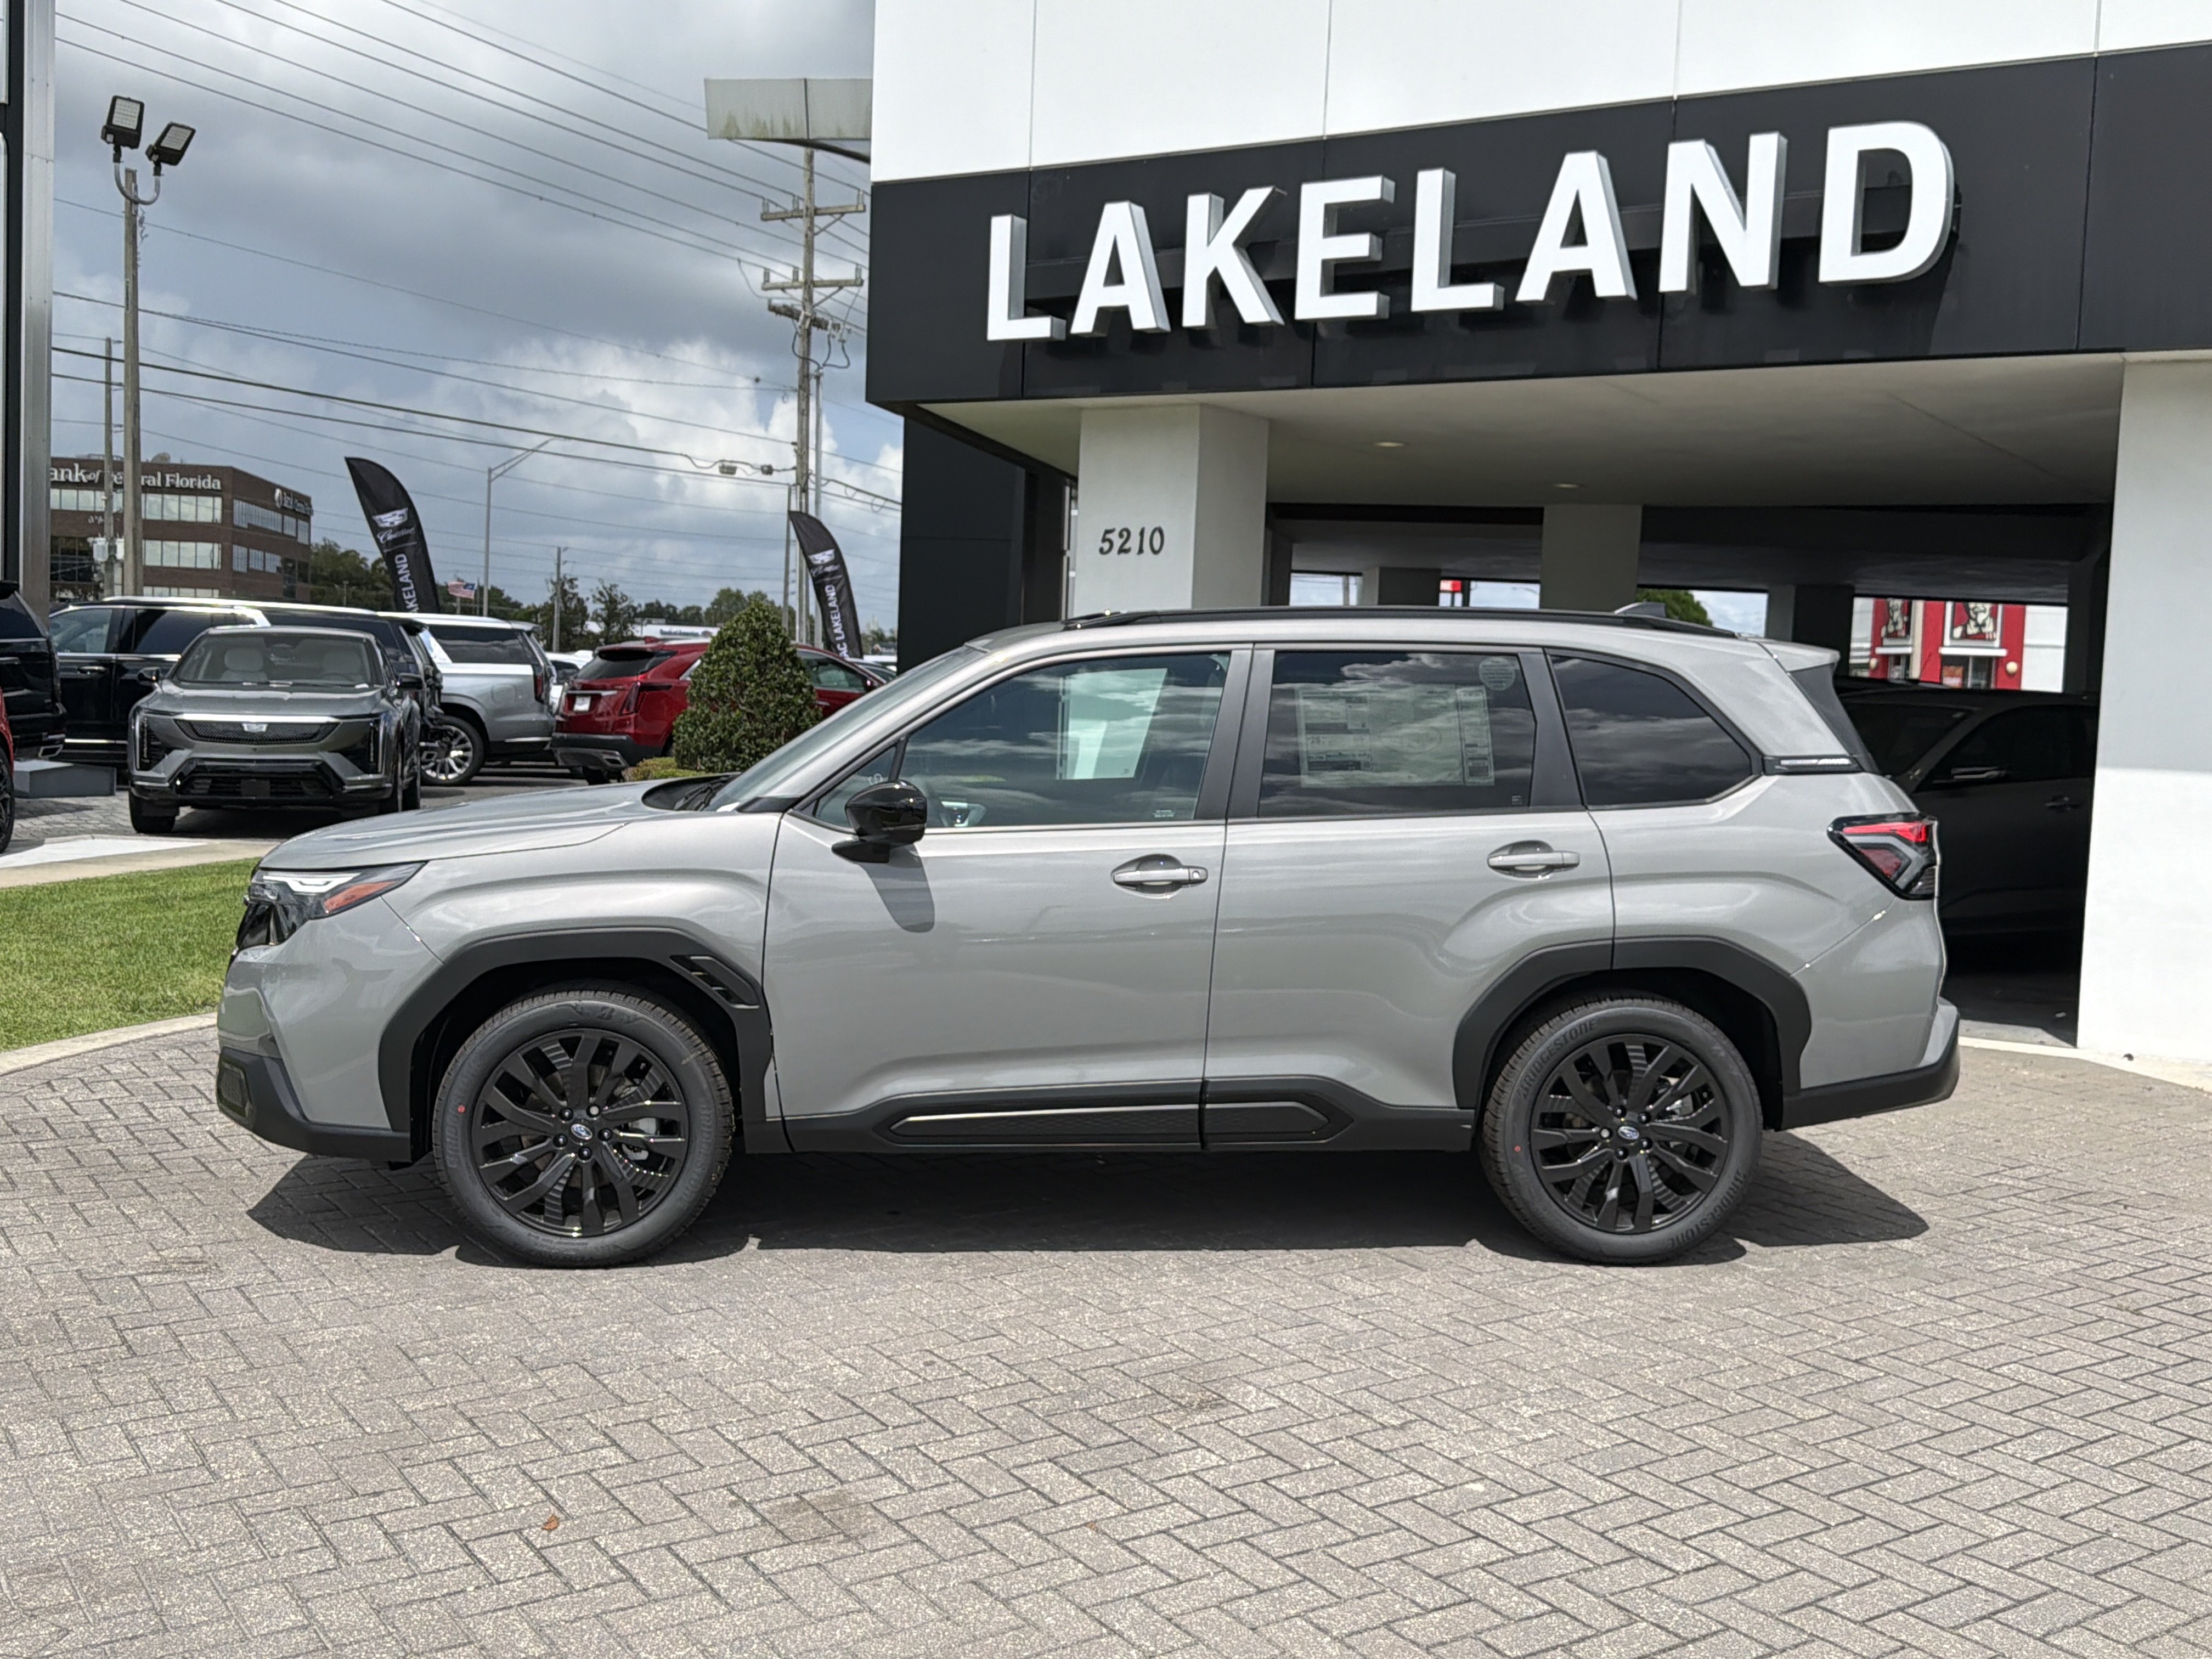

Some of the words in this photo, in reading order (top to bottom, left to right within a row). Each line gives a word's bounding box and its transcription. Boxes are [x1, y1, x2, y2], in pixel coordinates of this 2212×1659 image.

[988, 120, 1955, 341] LAKELAND
[50, 463, 87, 482] ank
[86, 470, 102, 483] of
[165, 473, 222, 489] Florida
[1099, 526, 1164, 555] 5210
[395, 554, 419, 613] KELAND
[825, 584, 845, 641] LAKELAND
[1517, 1018, 1598, 1098] BRIDGESTONE
[1668, 1169, 1746, 1248] BRIDGESTONE
